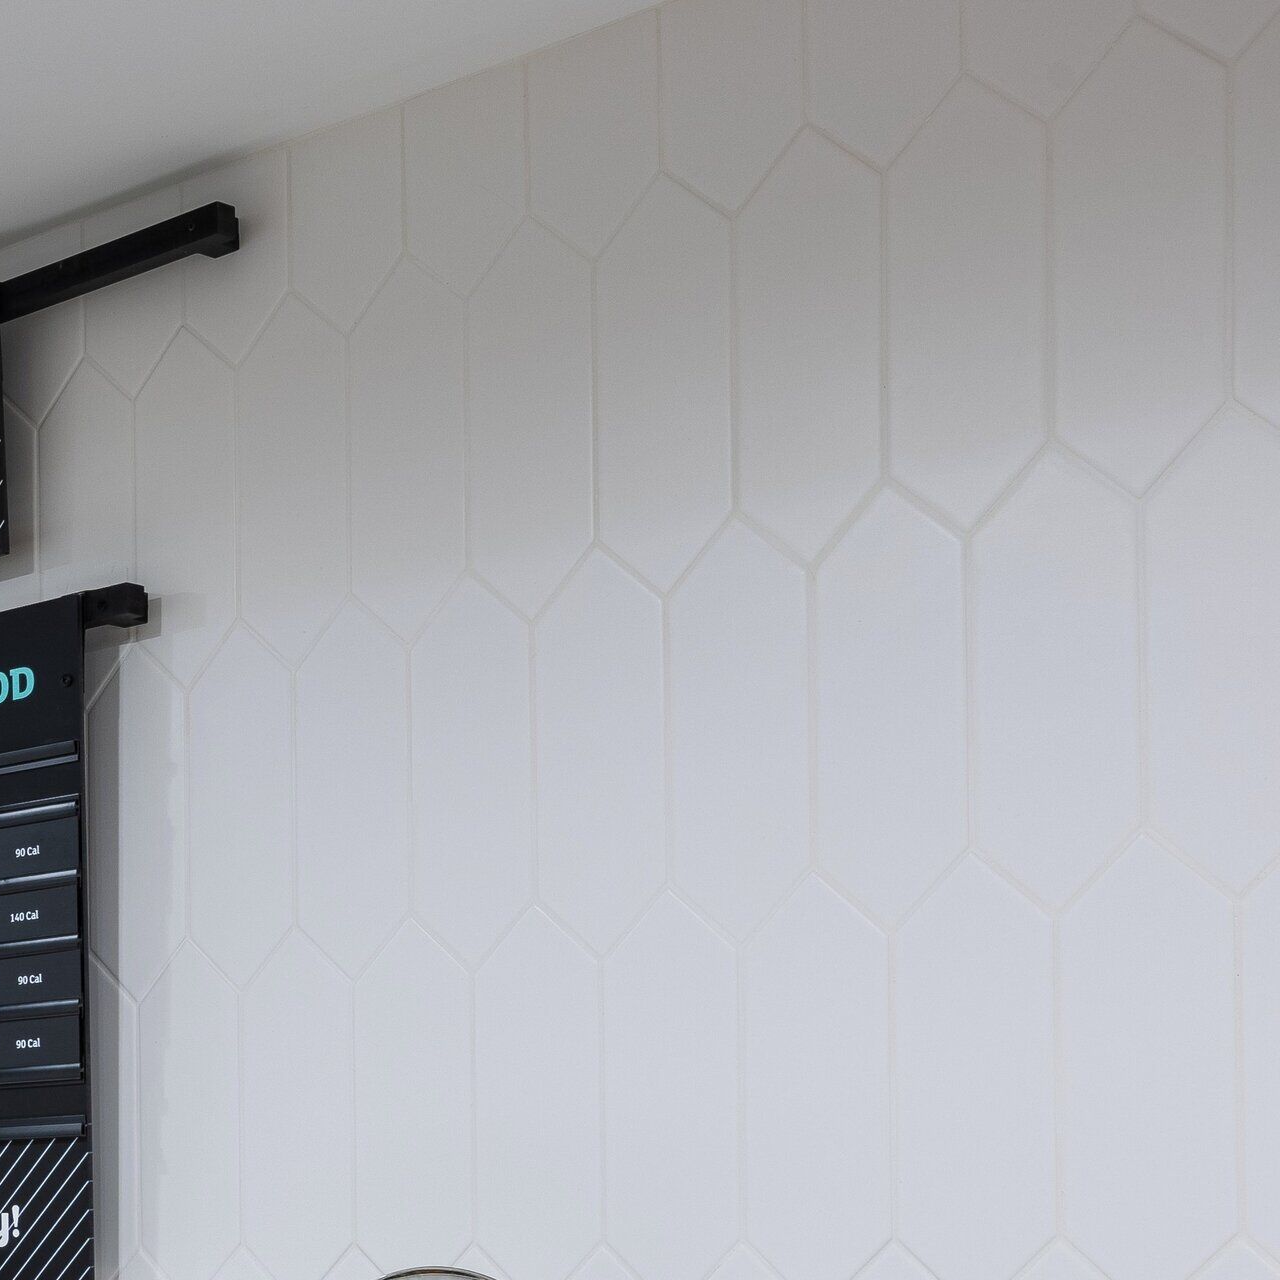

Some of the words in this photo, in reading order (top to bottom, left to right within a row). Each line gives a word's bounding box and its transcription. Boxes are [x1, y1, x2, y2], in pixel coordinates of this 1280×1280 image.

[15, 848, 25, 858] 90
[27, 845, 40, 856] Cal
[10, 912, 24, 923] 140
[25, 910, 39, 920] Cal
[18, 975, 28, 985] 90
[29, 973, 43, 984] Cal
[16, 1039, 26, 1049] 90
[27, 1037, 41, 1048] Cal
